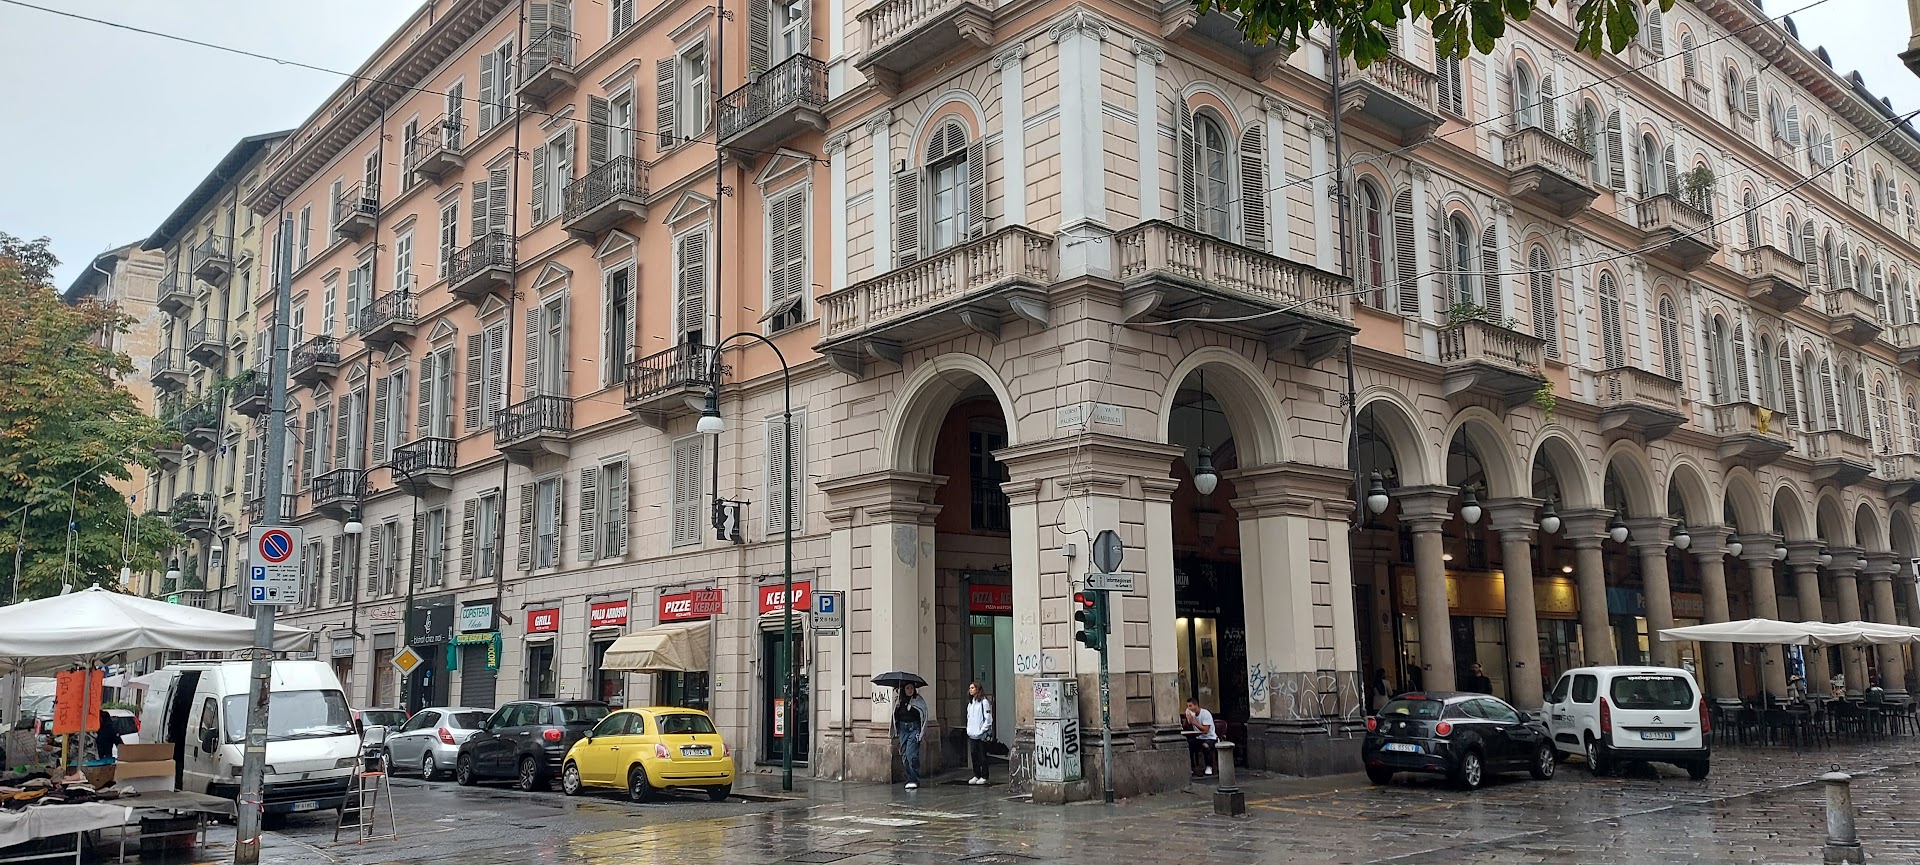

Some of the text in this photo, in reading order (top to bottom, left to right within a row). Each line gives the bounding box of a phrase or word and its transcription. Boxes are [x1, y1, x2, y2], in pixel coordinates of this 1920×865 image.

[254, 568, 263, 579] P
[254, 588, 263, 600] P
[694, 591, 718, 602] PIZZA
[693, 602, 721, 612] KEBAP
[822, 597, 832, 611] P
[463, 606, 489, 619] COPISTERIA
[591, 606, 627, 620] POLLO ARROSTO
[534, 614, 551, 627] GRILL
